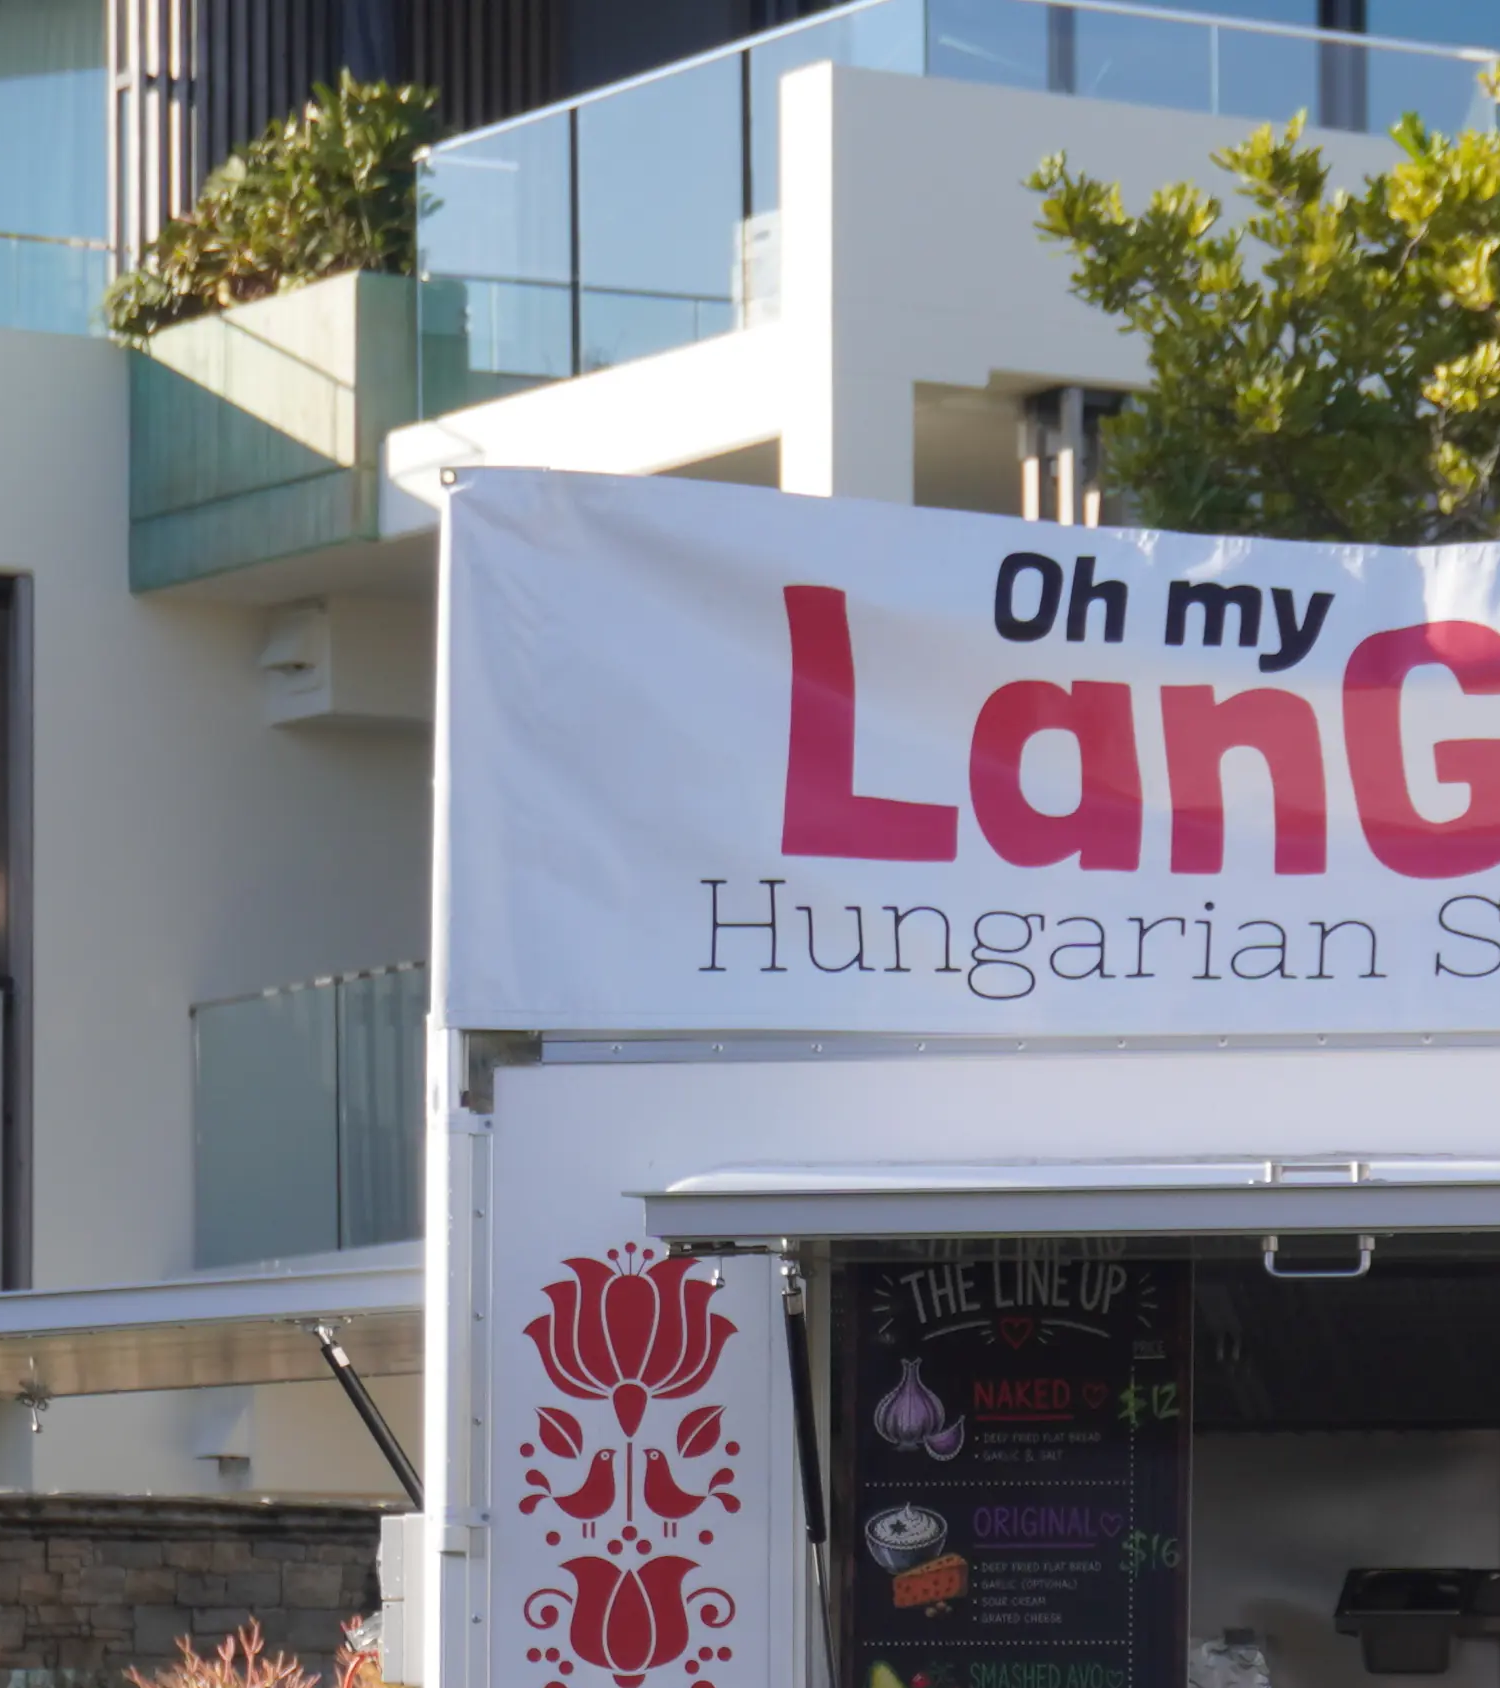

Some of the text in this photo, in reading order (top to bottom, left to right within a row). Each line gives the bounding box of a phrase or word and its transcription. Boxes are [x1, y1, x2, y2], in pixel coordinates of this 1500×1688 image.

[992, 549, 1335, 674] Oh my
[697, 876, 1388, 999] Hungarian
[900, 1260, 1128, 1324] THE LINE UP
[974, 1379, 1071, 1410] NAKED
[1117, 1381, 1181, 1430] $12
[973, 1506, 1098, 1538] ORIGINAL
[1069, 1561, 1102, 1572] BREAD
[1120, 1530, 1181, 1578] $16
[981, 1596, 1046, 1607] SOUR CREAM
[981, 1613, 1062, 1624] GRATED CHEESE
